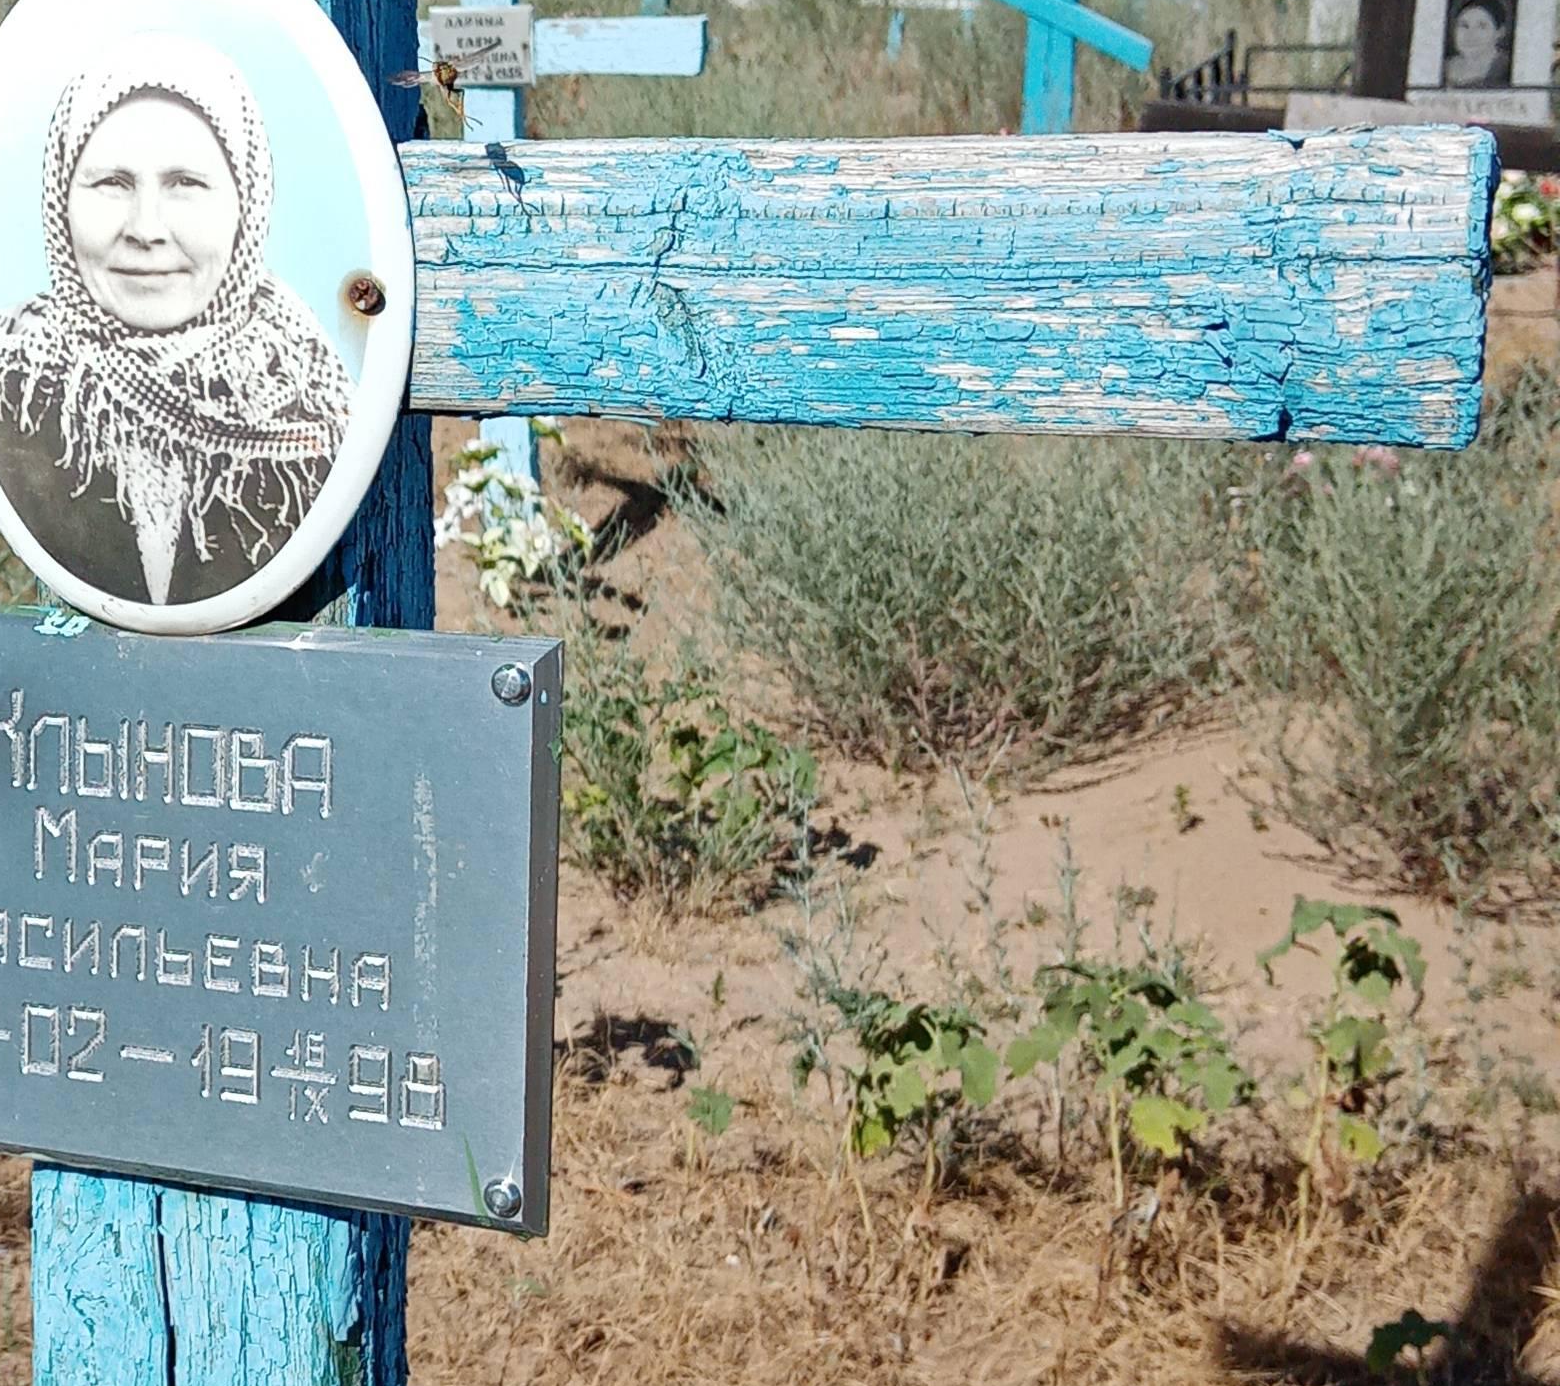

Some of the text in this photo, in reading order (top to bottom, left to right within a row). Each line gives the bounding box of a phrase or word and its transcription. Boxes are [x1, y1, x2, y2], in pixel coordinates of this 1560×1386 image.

[33, 806, 268, 905] МАРИЯ
[20, 1002, 108, 1083] 02
[191, 1022, 260, 1105] 19
[348, 1044, 447, 1131] 98
